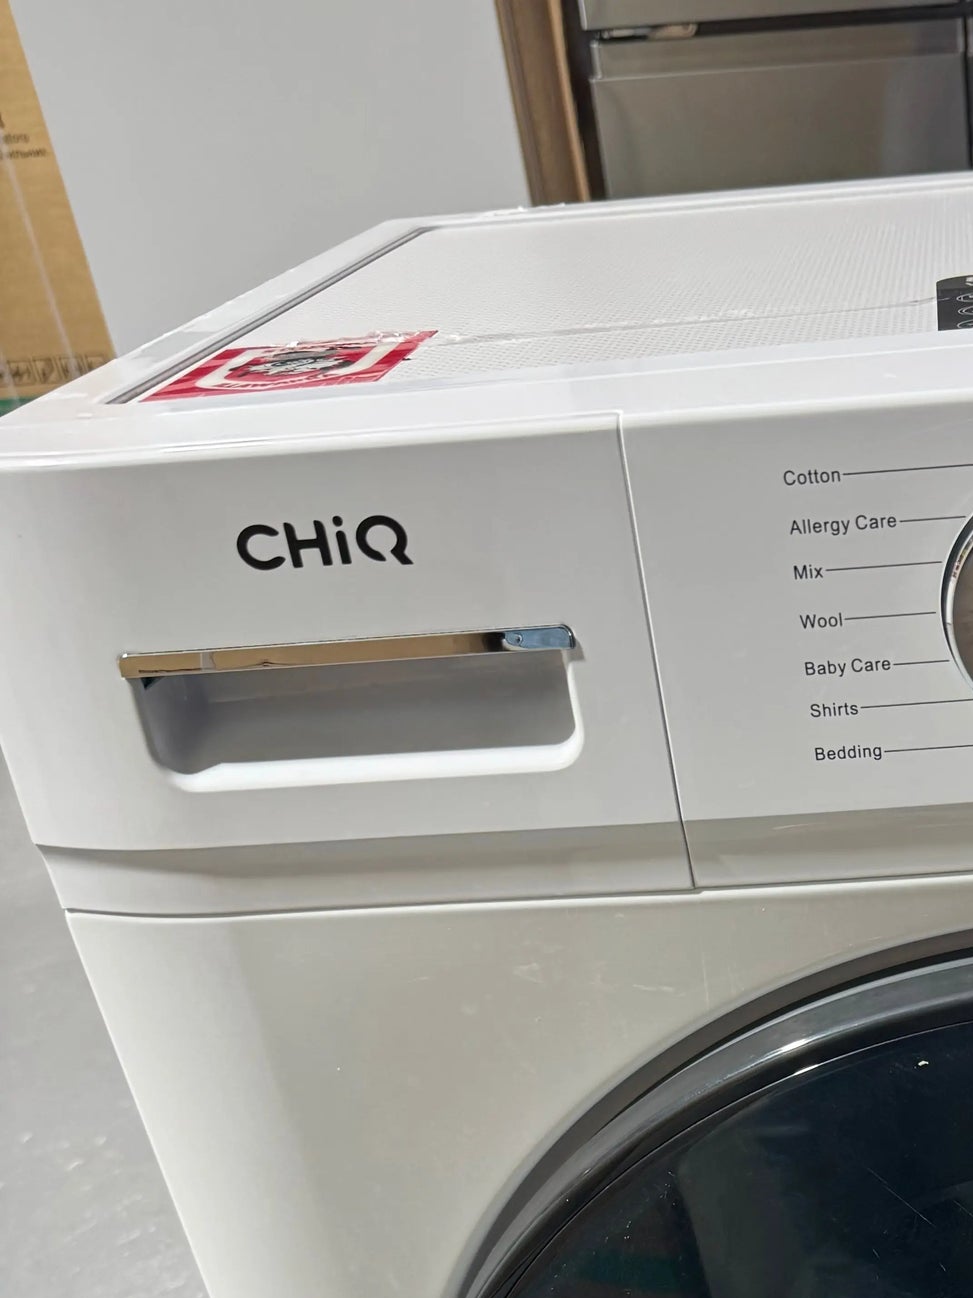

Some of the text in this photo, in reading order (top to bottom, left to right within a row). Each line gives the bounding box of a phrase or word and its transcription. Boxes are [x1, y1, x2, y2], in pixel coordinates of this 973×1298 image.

[783, 467, 841, 486] Cotton
[789, 513, 898, 537] Allergy Care
[793, 563, 824, 581] Mix
[800, 611, 844, 629] Wool
[804, 656, 891, 680] Baby Care
[810, 700, 859, 719] Shirts
[814, 742, 882, 763] Bedding
